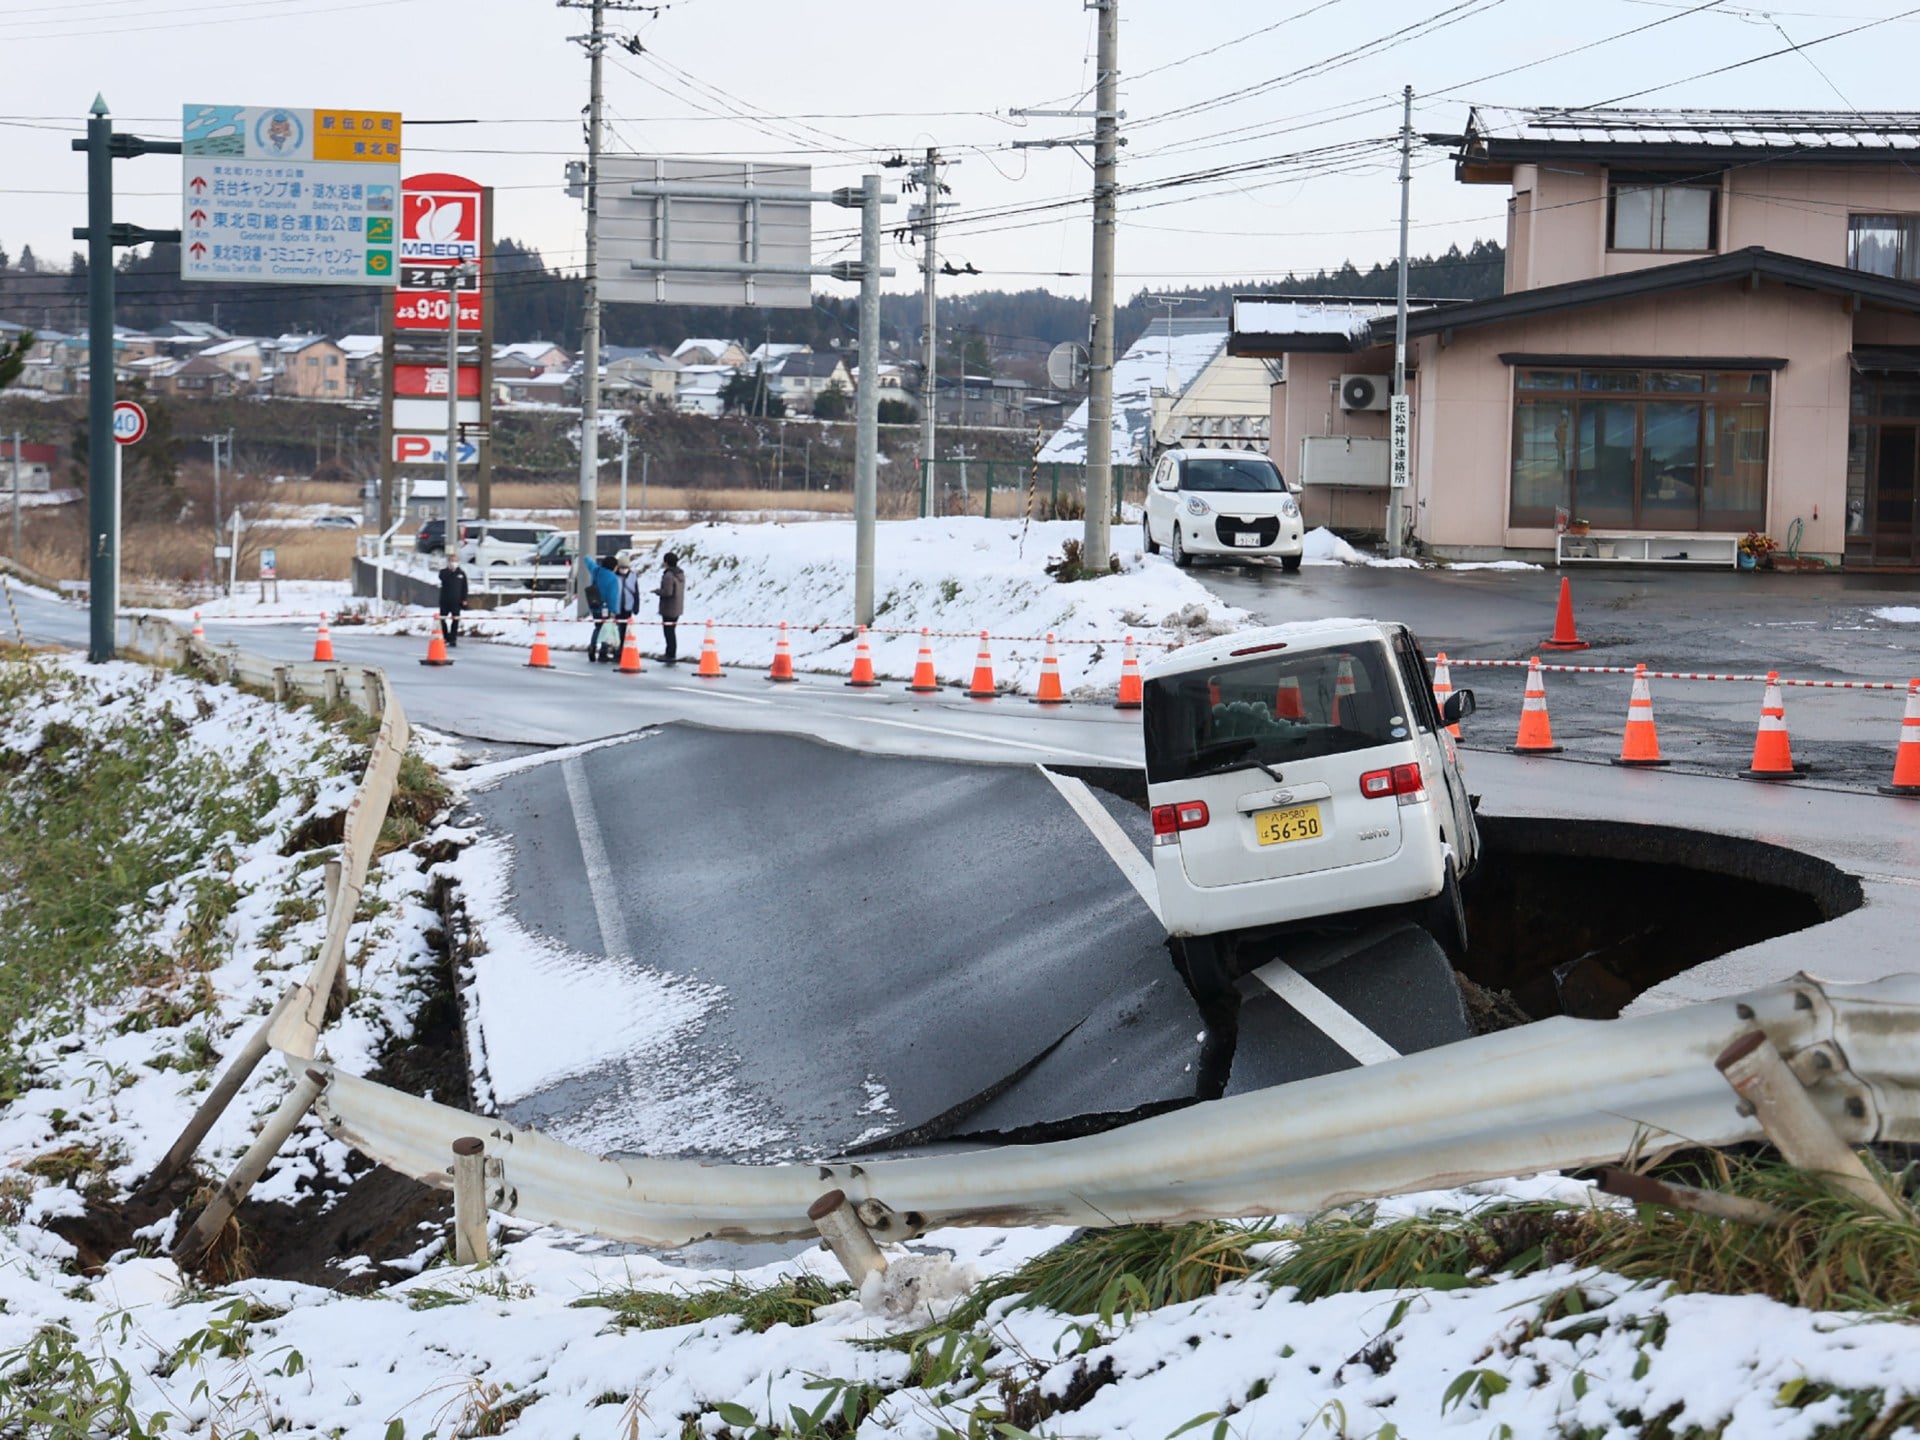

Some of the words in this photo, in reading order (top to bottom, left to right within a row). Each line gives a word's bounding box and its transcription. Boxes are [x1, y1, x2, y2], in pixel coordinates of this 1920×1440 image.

[322, 116, 393, 131] 駅伝の町
[352, 142, 399, 155] 東北町
[213, 212, 362, 232] 東北町総合運動公園
[240, 231, 275, 241] General
[281, 232, 310, 242] Sports
[315, 234, 335, 243] Park
[402, 242, 475, 258] MAEDA
[272, 265, 322, 276] Community
[328, 266, 358, 275] Center
[424, 368, 450, 394] 酒
[113, 414, 137, 432] 40
[397, 437, 431, 461] P
[1394, 401, 1406, 484] 花松神社連絡所
[1271, 809, 1306, 822] 八戸580
[1270, 818, 1318, 841] 56-50
